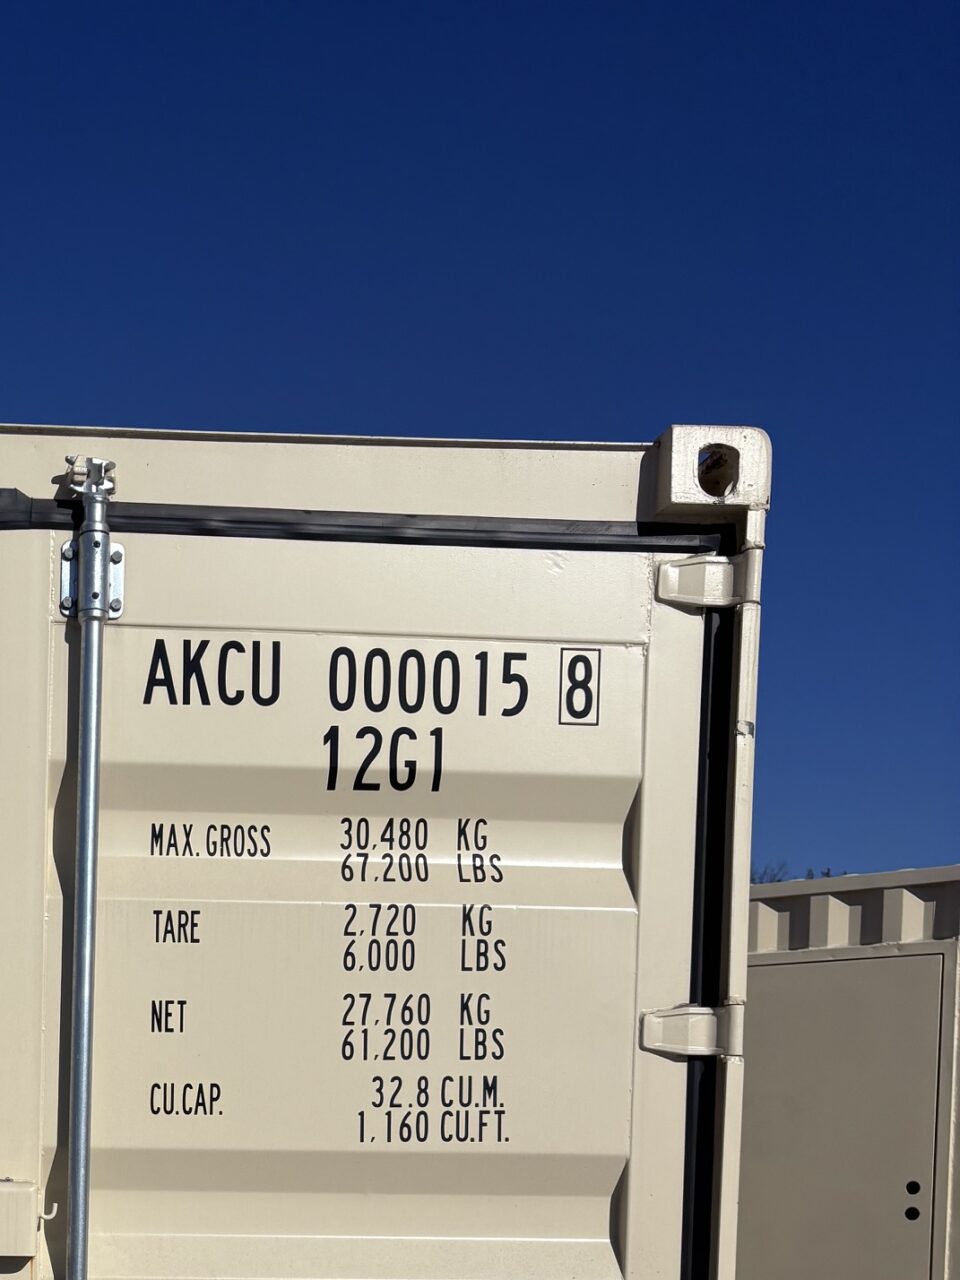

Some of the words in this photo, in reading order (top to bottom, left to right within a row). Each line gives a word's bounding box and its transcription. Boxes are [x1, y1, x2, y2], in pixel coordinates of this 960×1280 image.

[143, 638, 281, 707] AKCU
[329, 646, 529, 717] 000015
[566, 654, 594, 719] 8
[323, 725, 443, 792] 12G1
[457, 818, 488, 851] KG
[457, 852, 504, 883] LBS
[153, 910, 201, 944] TARE
[462, 904, 492, 937] KG
[461, 938, 506, 972] LBS
[151, 1000, 187, 1033] NET
[460, 993, 490, 1026] KG
[459, 1028, 504, 1061] LBS
[150, 1082, 223, 1116] CU.CAP.
[371, 1075, 429, 1108] 32.8
[440, 1075, 504, 1108] CU.M.
[440, 1110, 510, 1143] CU.FT.
